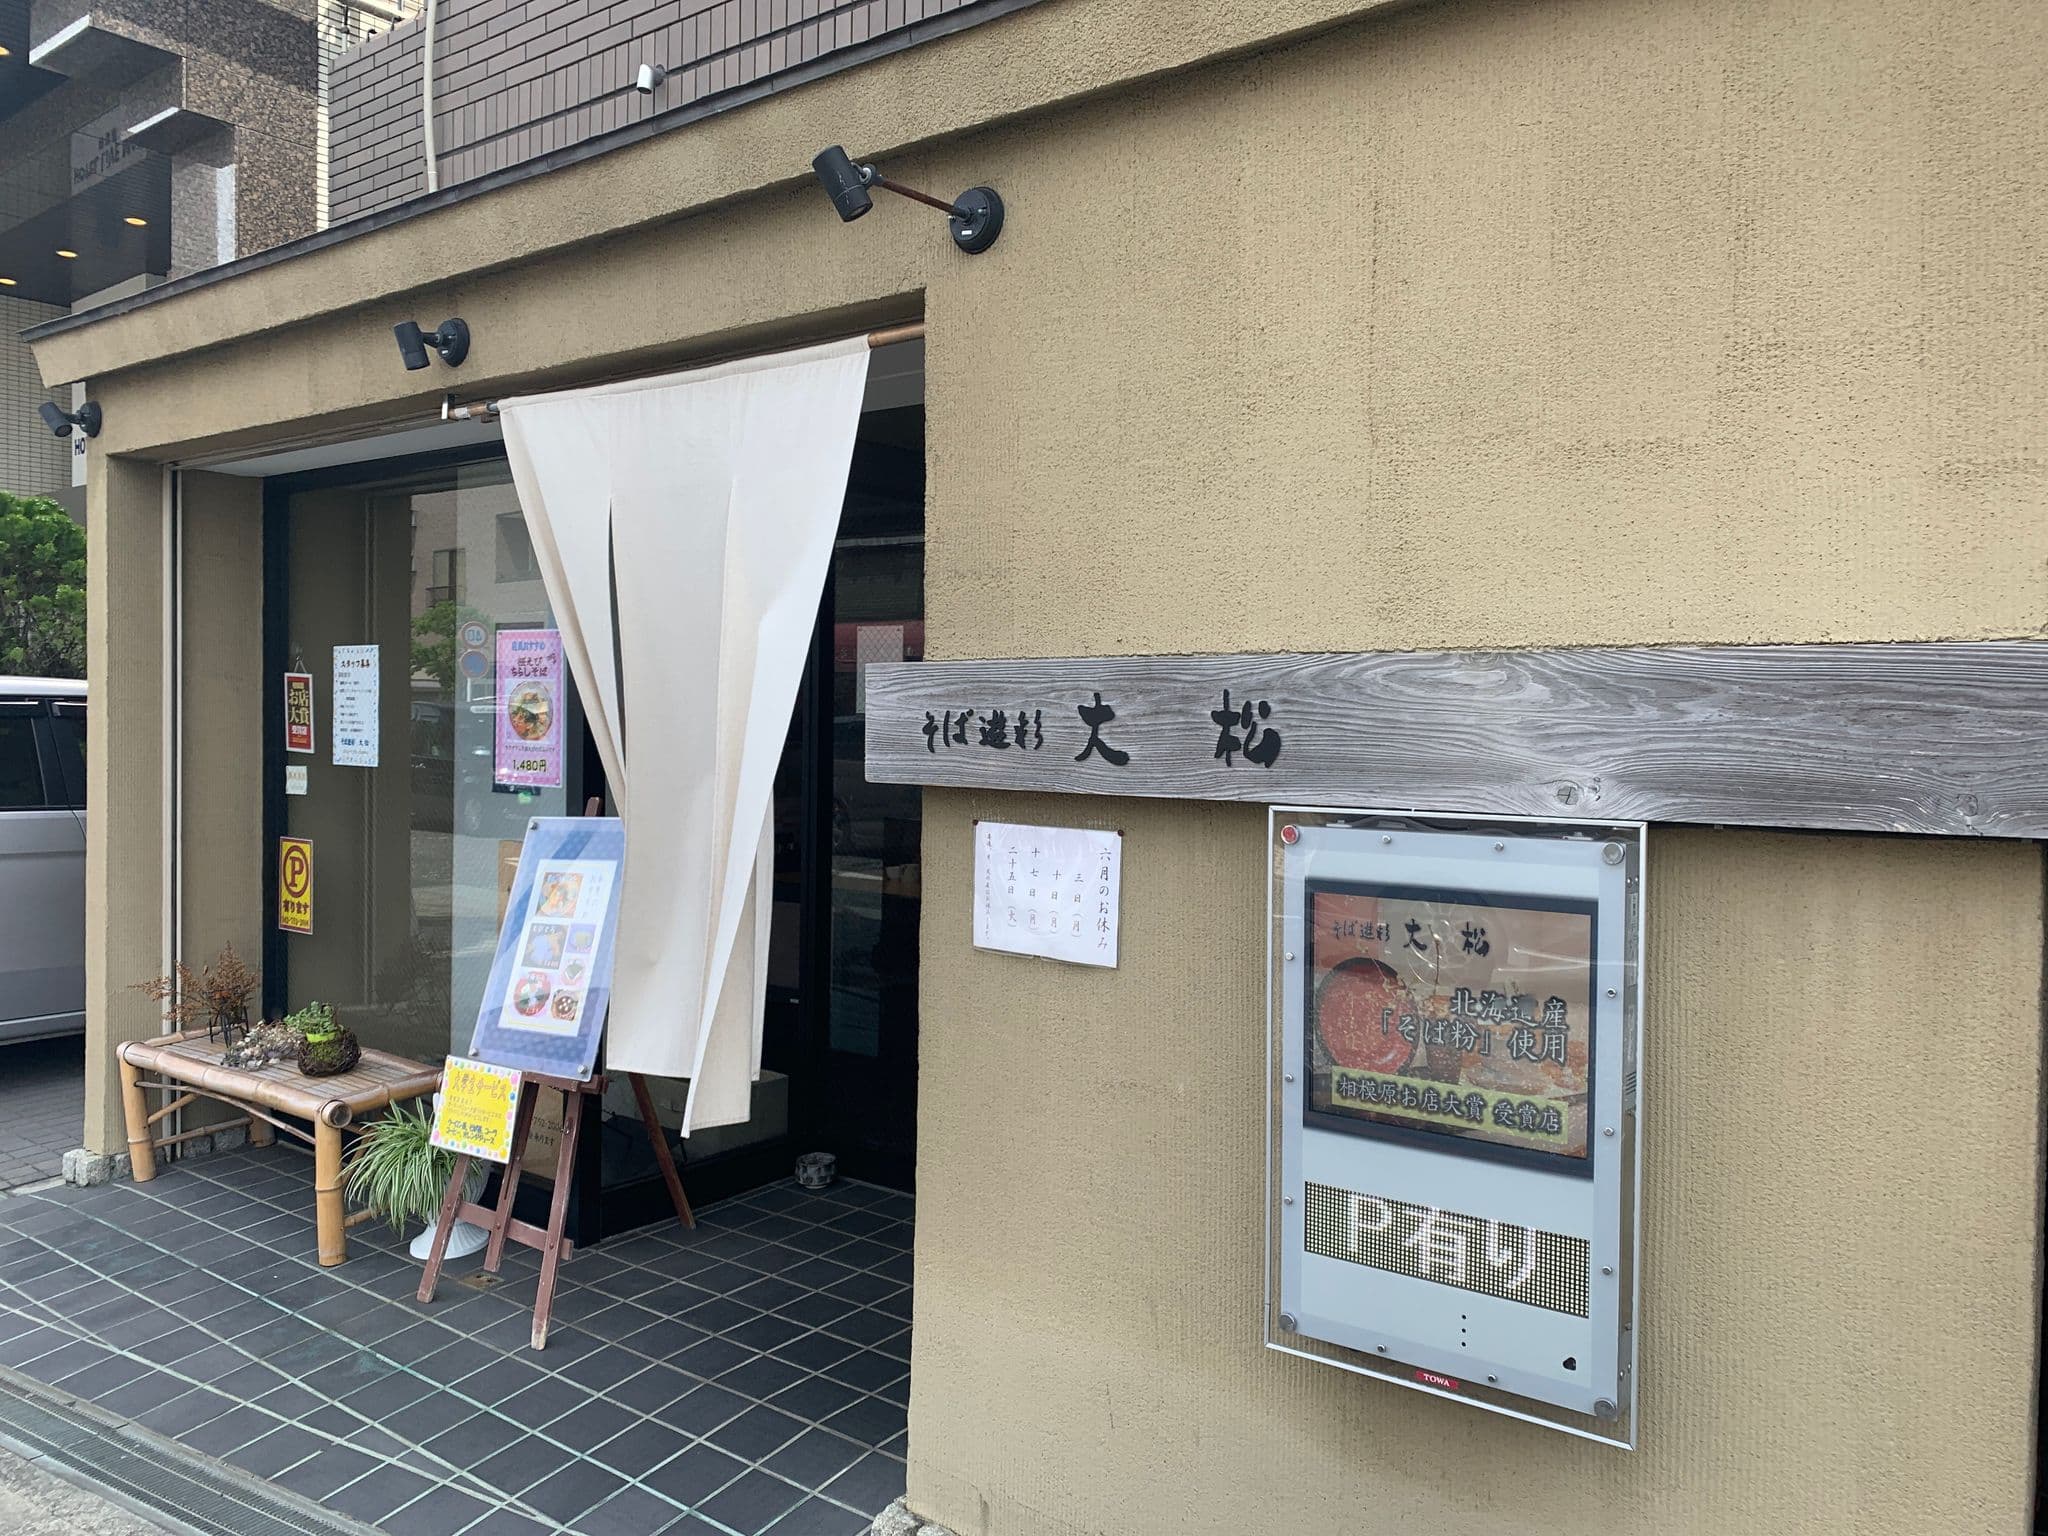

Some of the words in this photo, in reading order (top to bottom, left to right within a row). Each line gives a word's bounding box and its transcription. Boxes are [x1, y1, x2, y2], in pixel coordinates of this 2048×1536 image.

[513, 759, 547, 773] 1,480円
[283, 899, 310, 915] 有ります
[1096, 847, 1113, 950] 六月のお休み
[1339, 1075, 1486, 1121] 相模原お店大賞
[1493, 1101, 1563, 1133] 受賞店
[1348, 1191, 1538, 1289] P有り
[1423, 1373, 1451, 1387] TOWA
